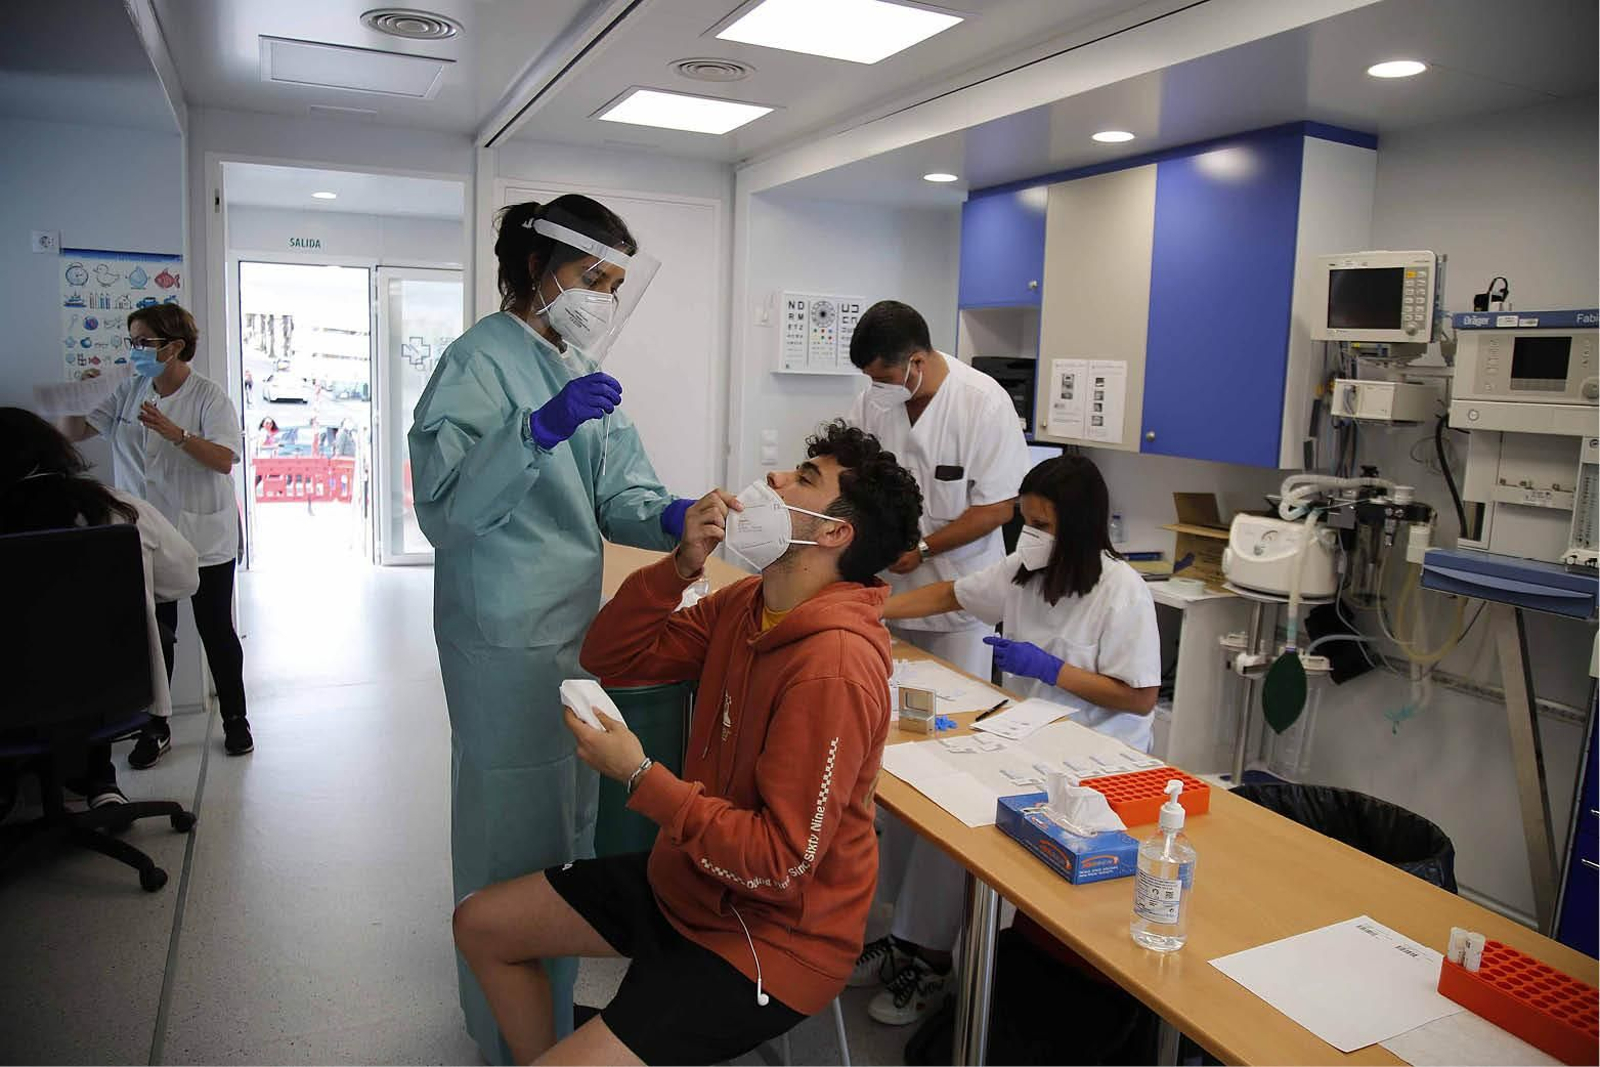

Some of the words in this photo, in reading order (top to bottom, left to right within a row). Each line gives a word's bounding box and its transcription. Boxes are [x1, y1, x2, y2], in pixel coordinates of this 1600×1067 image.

[289, 237, 321, 248] SALIDA
[810, 806, 826, 832] Nine
[803, 833, 819, 862] Sixty
